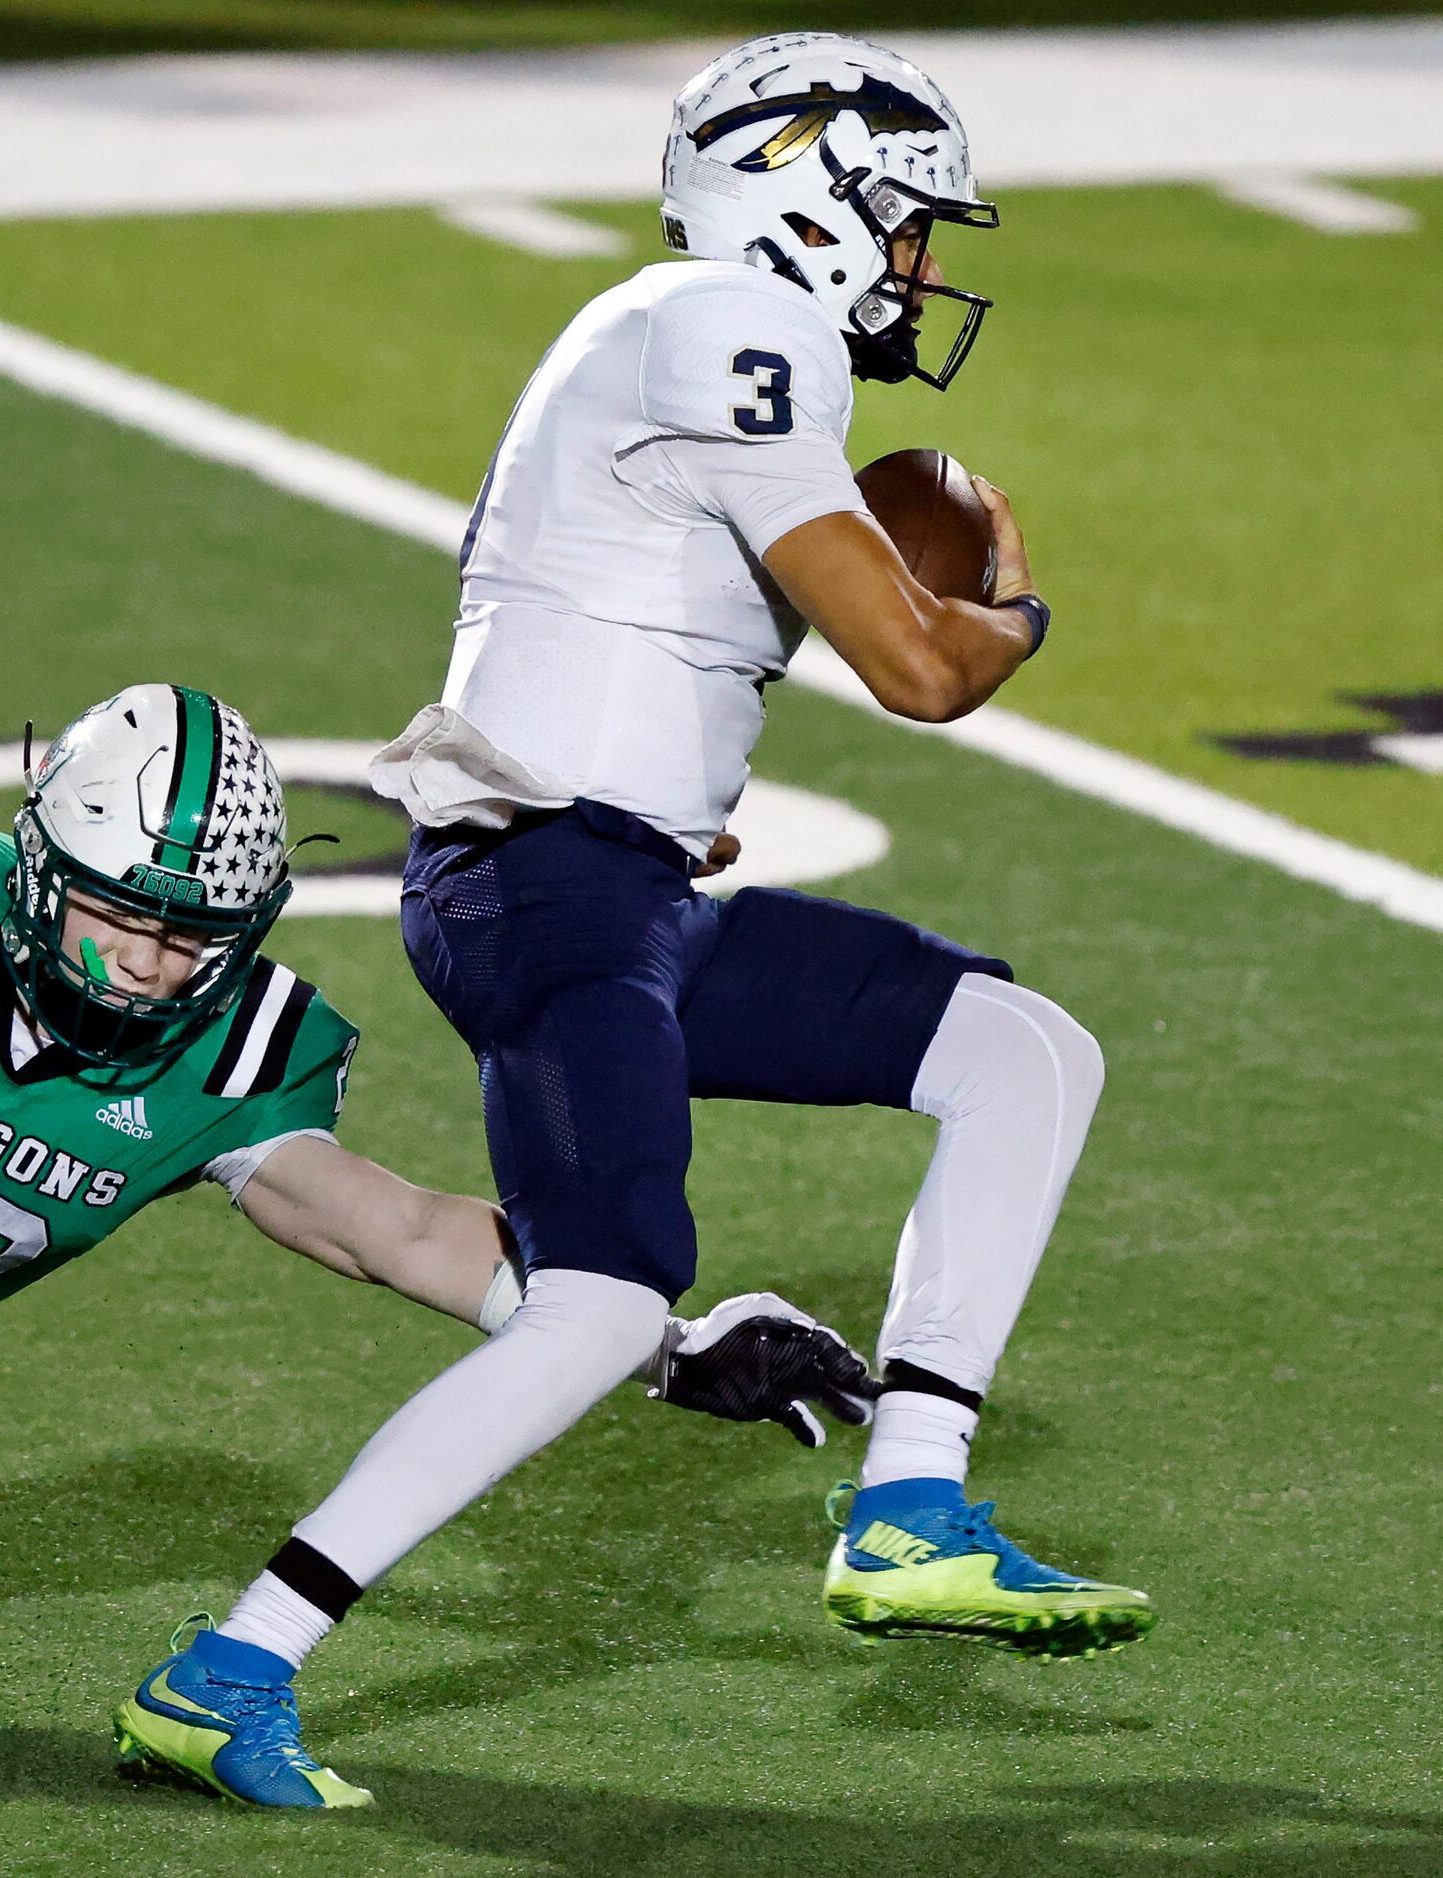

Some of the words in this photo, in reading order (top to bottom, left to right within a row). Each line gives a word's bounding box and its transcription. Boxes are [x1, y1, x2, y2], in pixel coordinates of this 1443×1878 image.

[727, 344, 797, 438] 3
[130, 865, 204, 904] 76092
[96, 1108, 153, 1140] adidas
